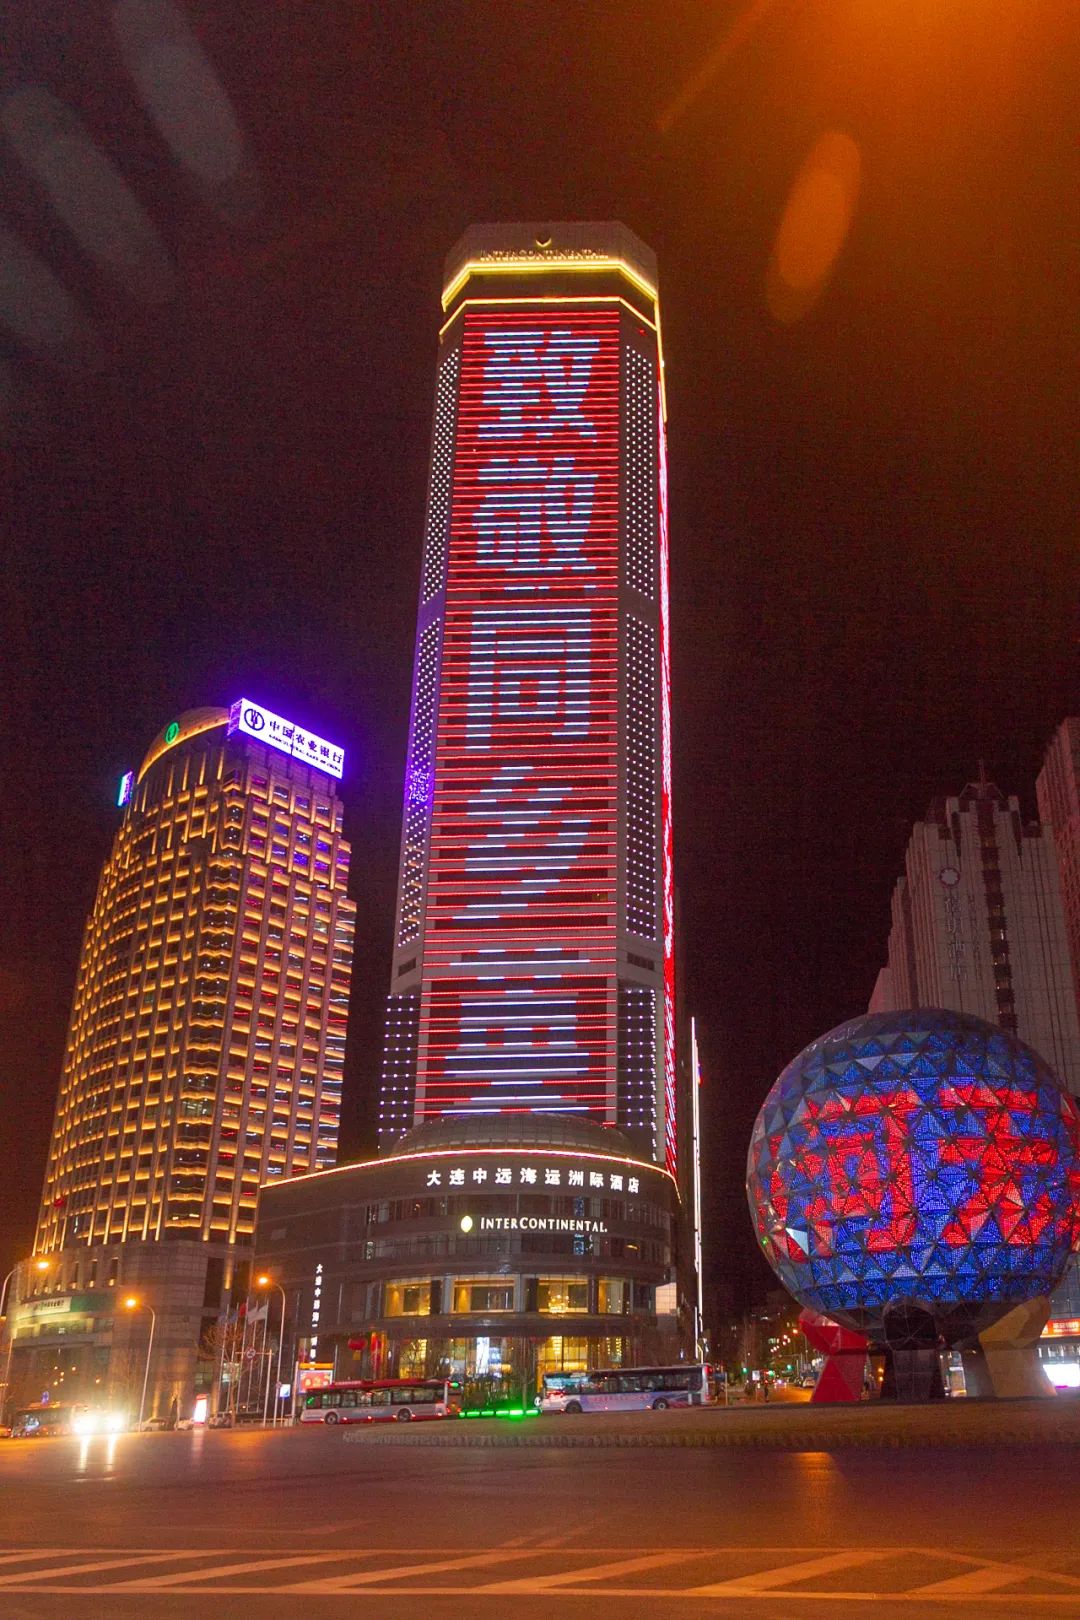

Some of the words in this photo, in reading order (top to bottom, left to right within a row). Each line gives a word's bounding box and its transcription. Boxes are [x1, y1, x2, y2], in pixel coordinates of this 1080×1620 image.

[270, 720, 342, 763] 中国农业银行
[426, 1167, 640, 1194] 大连中远海运洲际酒店
